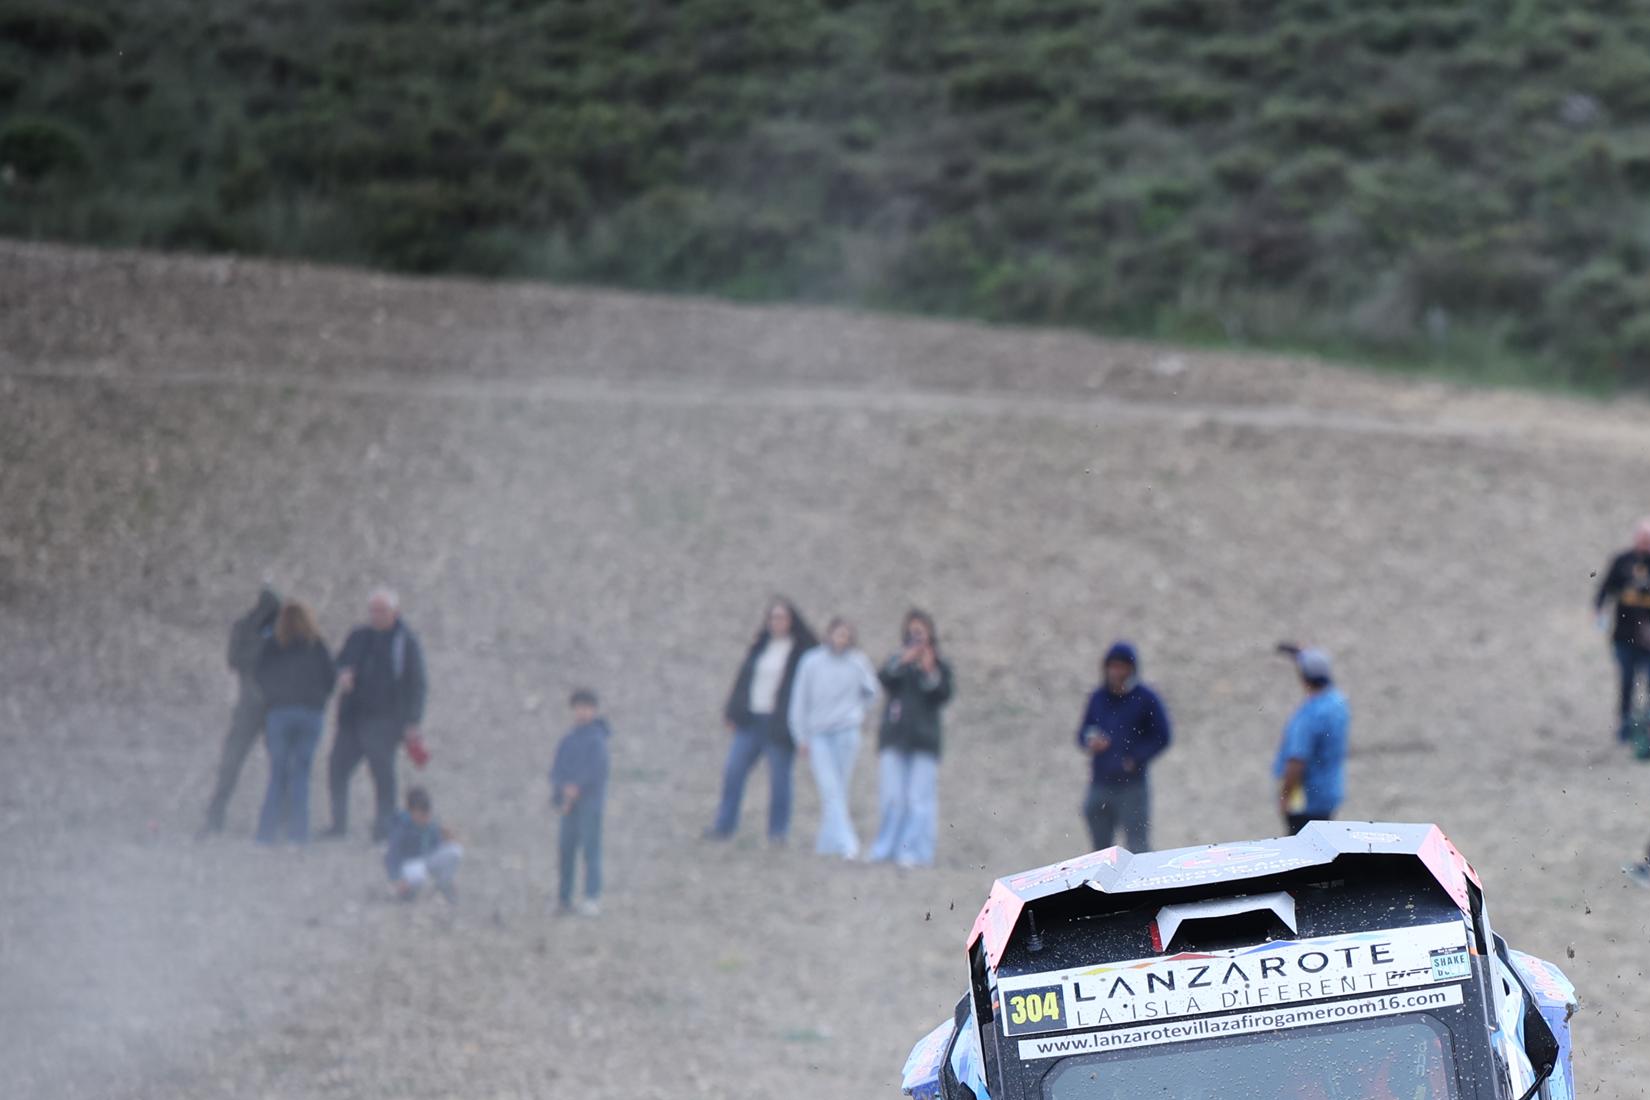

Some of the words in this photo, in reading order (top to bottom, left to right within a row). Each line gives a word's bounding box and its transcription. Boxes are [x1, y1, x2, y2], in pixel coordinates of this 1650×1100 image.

[1073, 942, 1394, 1002] LANZAROTE
[1434, 954, 1465, 967] SHAKE
[1009, 991, 1060, 1025] 304
[1036, 991, 1446, 1054] www.lanzarotevillazafirogameroom16.com
[1077, 1007, 1113, 1026] LA
[1132, 997, 1201, 1019] ISLA
[1222, 971, 1399, 1008] DIFERENTE
